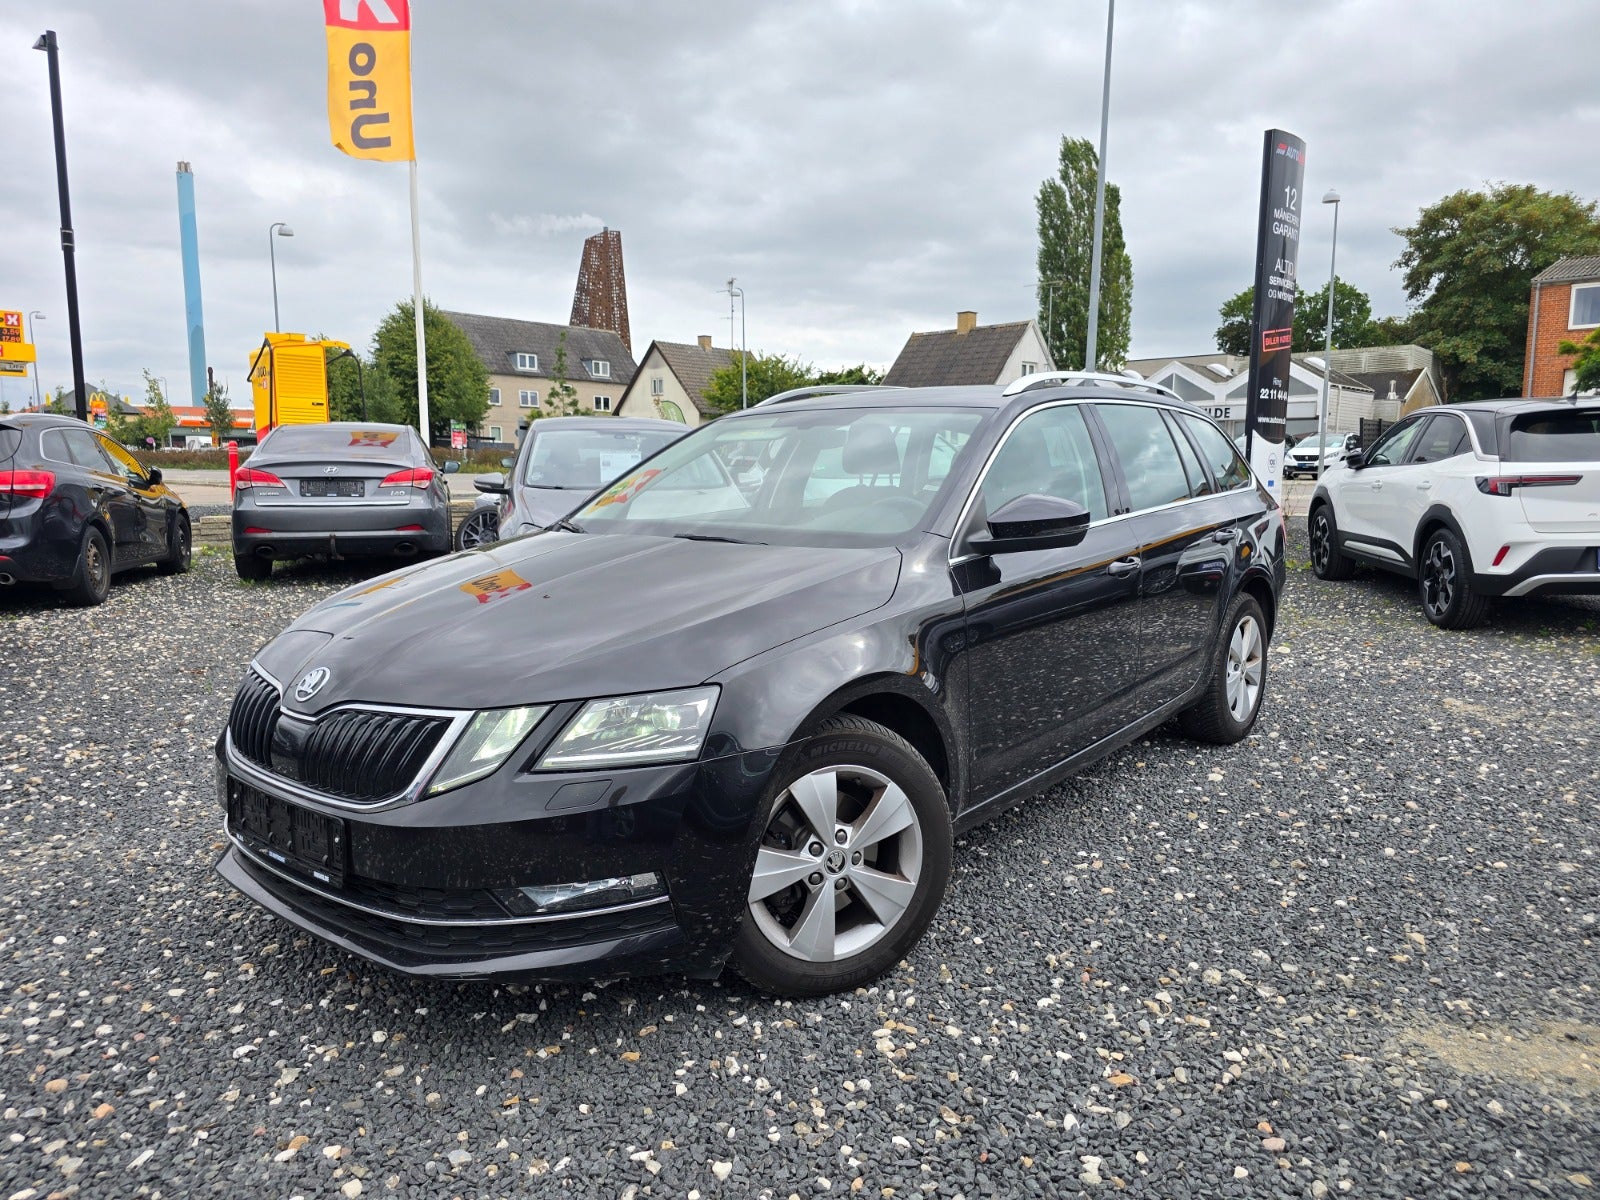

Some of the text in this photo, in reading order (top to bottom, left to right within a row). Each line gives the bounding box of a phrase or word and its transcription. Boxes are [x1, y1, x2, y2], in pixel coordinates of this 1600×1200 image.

[1284, 185, 1297, 211] 12
[1274, 257, 1294, 276] ALTID
[1268, 289, 1277, 299] OG
[1259, 388, 1269, 399] 22
[1270, 388, 1277, 400] 11
[810, 740, 880, 758] MICHELIN
